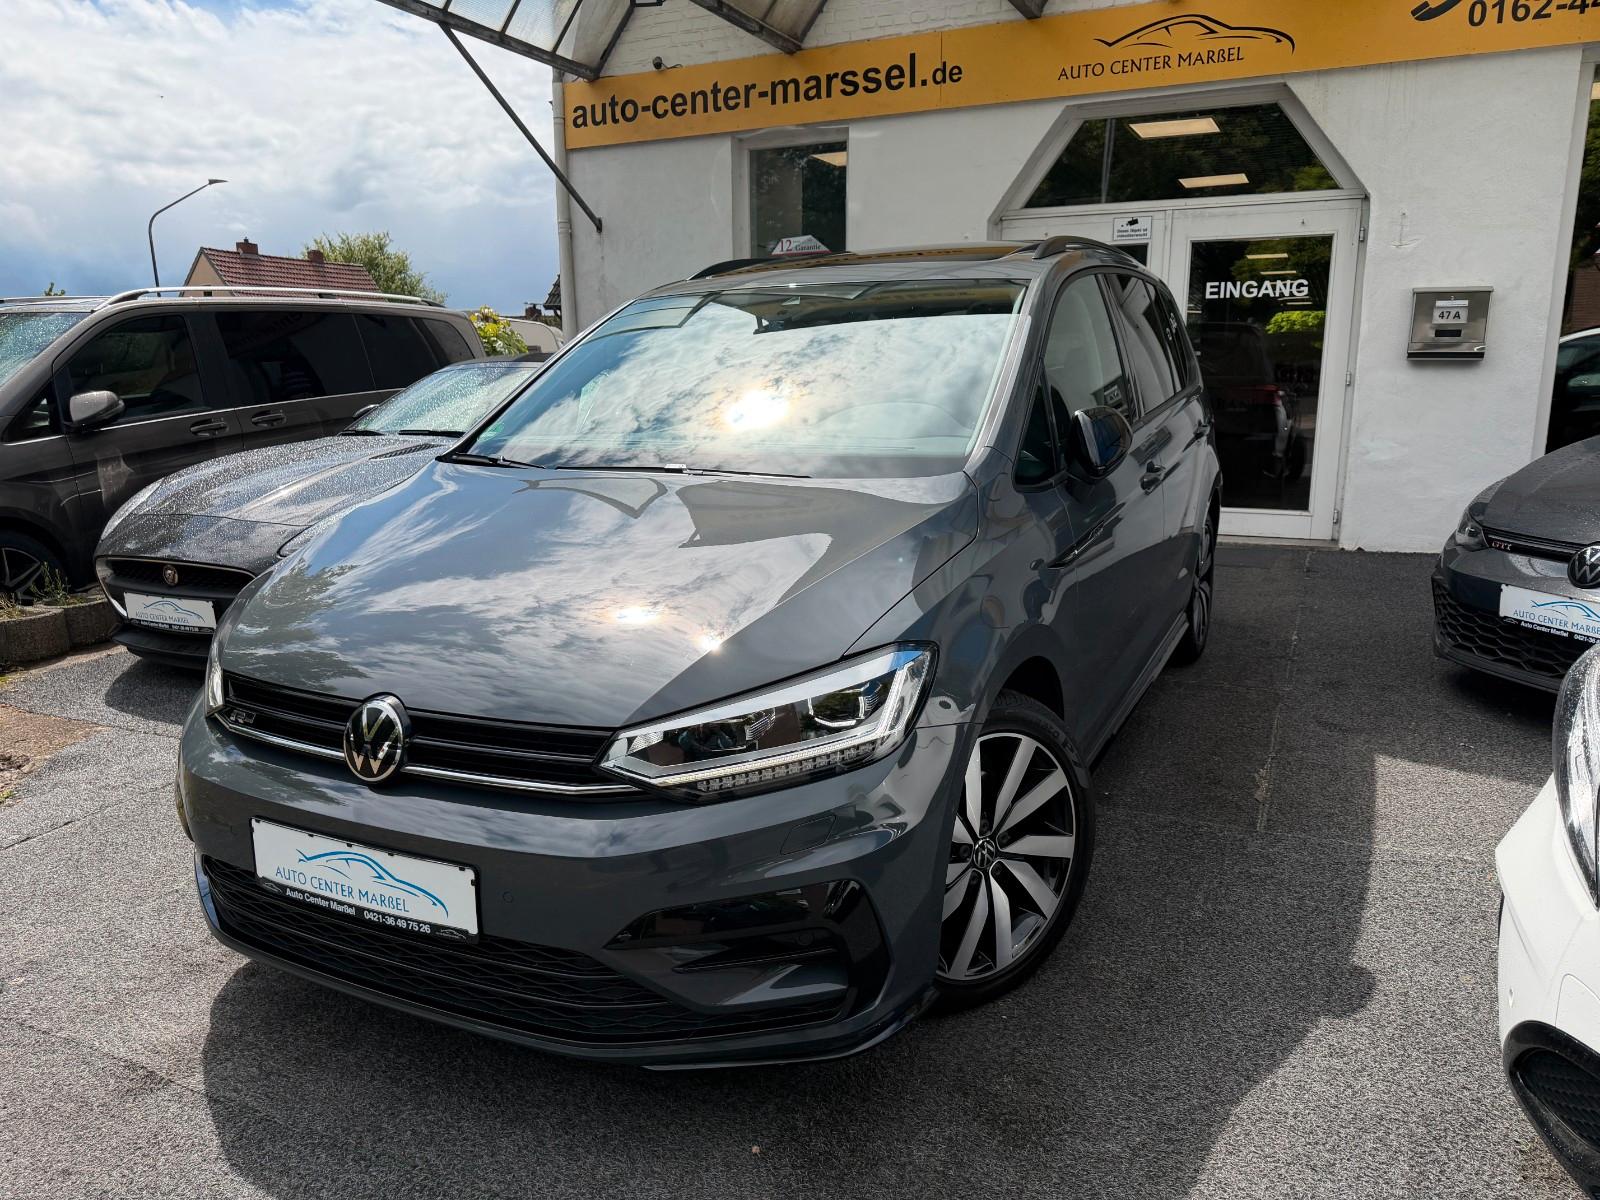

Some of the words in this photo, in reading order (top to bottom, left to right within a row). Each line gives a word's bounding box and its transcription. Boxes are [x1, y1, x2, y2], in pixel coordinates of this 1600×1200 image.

[1468, 0, 1600, 27] 0162-4
[1057, 62, 1105, 81] AUTO
[1110, 54, 1172, 75] CENTER
[572, 53, 963, 129] auto-center-marssel.de
[779, 239, 793, 252] 12
[1205, 279, 1309, 300] EINGANG
[1438, 311, 1451, 320] 47
[1453, 311, 1461, 320] A
[1513, 609, 1536, 621] AUTO
[1537, 614, 1568, 629] CENTER
[275, 866, 307, 885] AUTO
[310, 876, 354, 899] CENTER
[286, 888, 303, 900] Auto
[304, 893, 329, 908] Center
[363, 910, 396, 926] 0421-36
[408, 921, 419, 932] 75
[419, 923, 431, 934] 26
